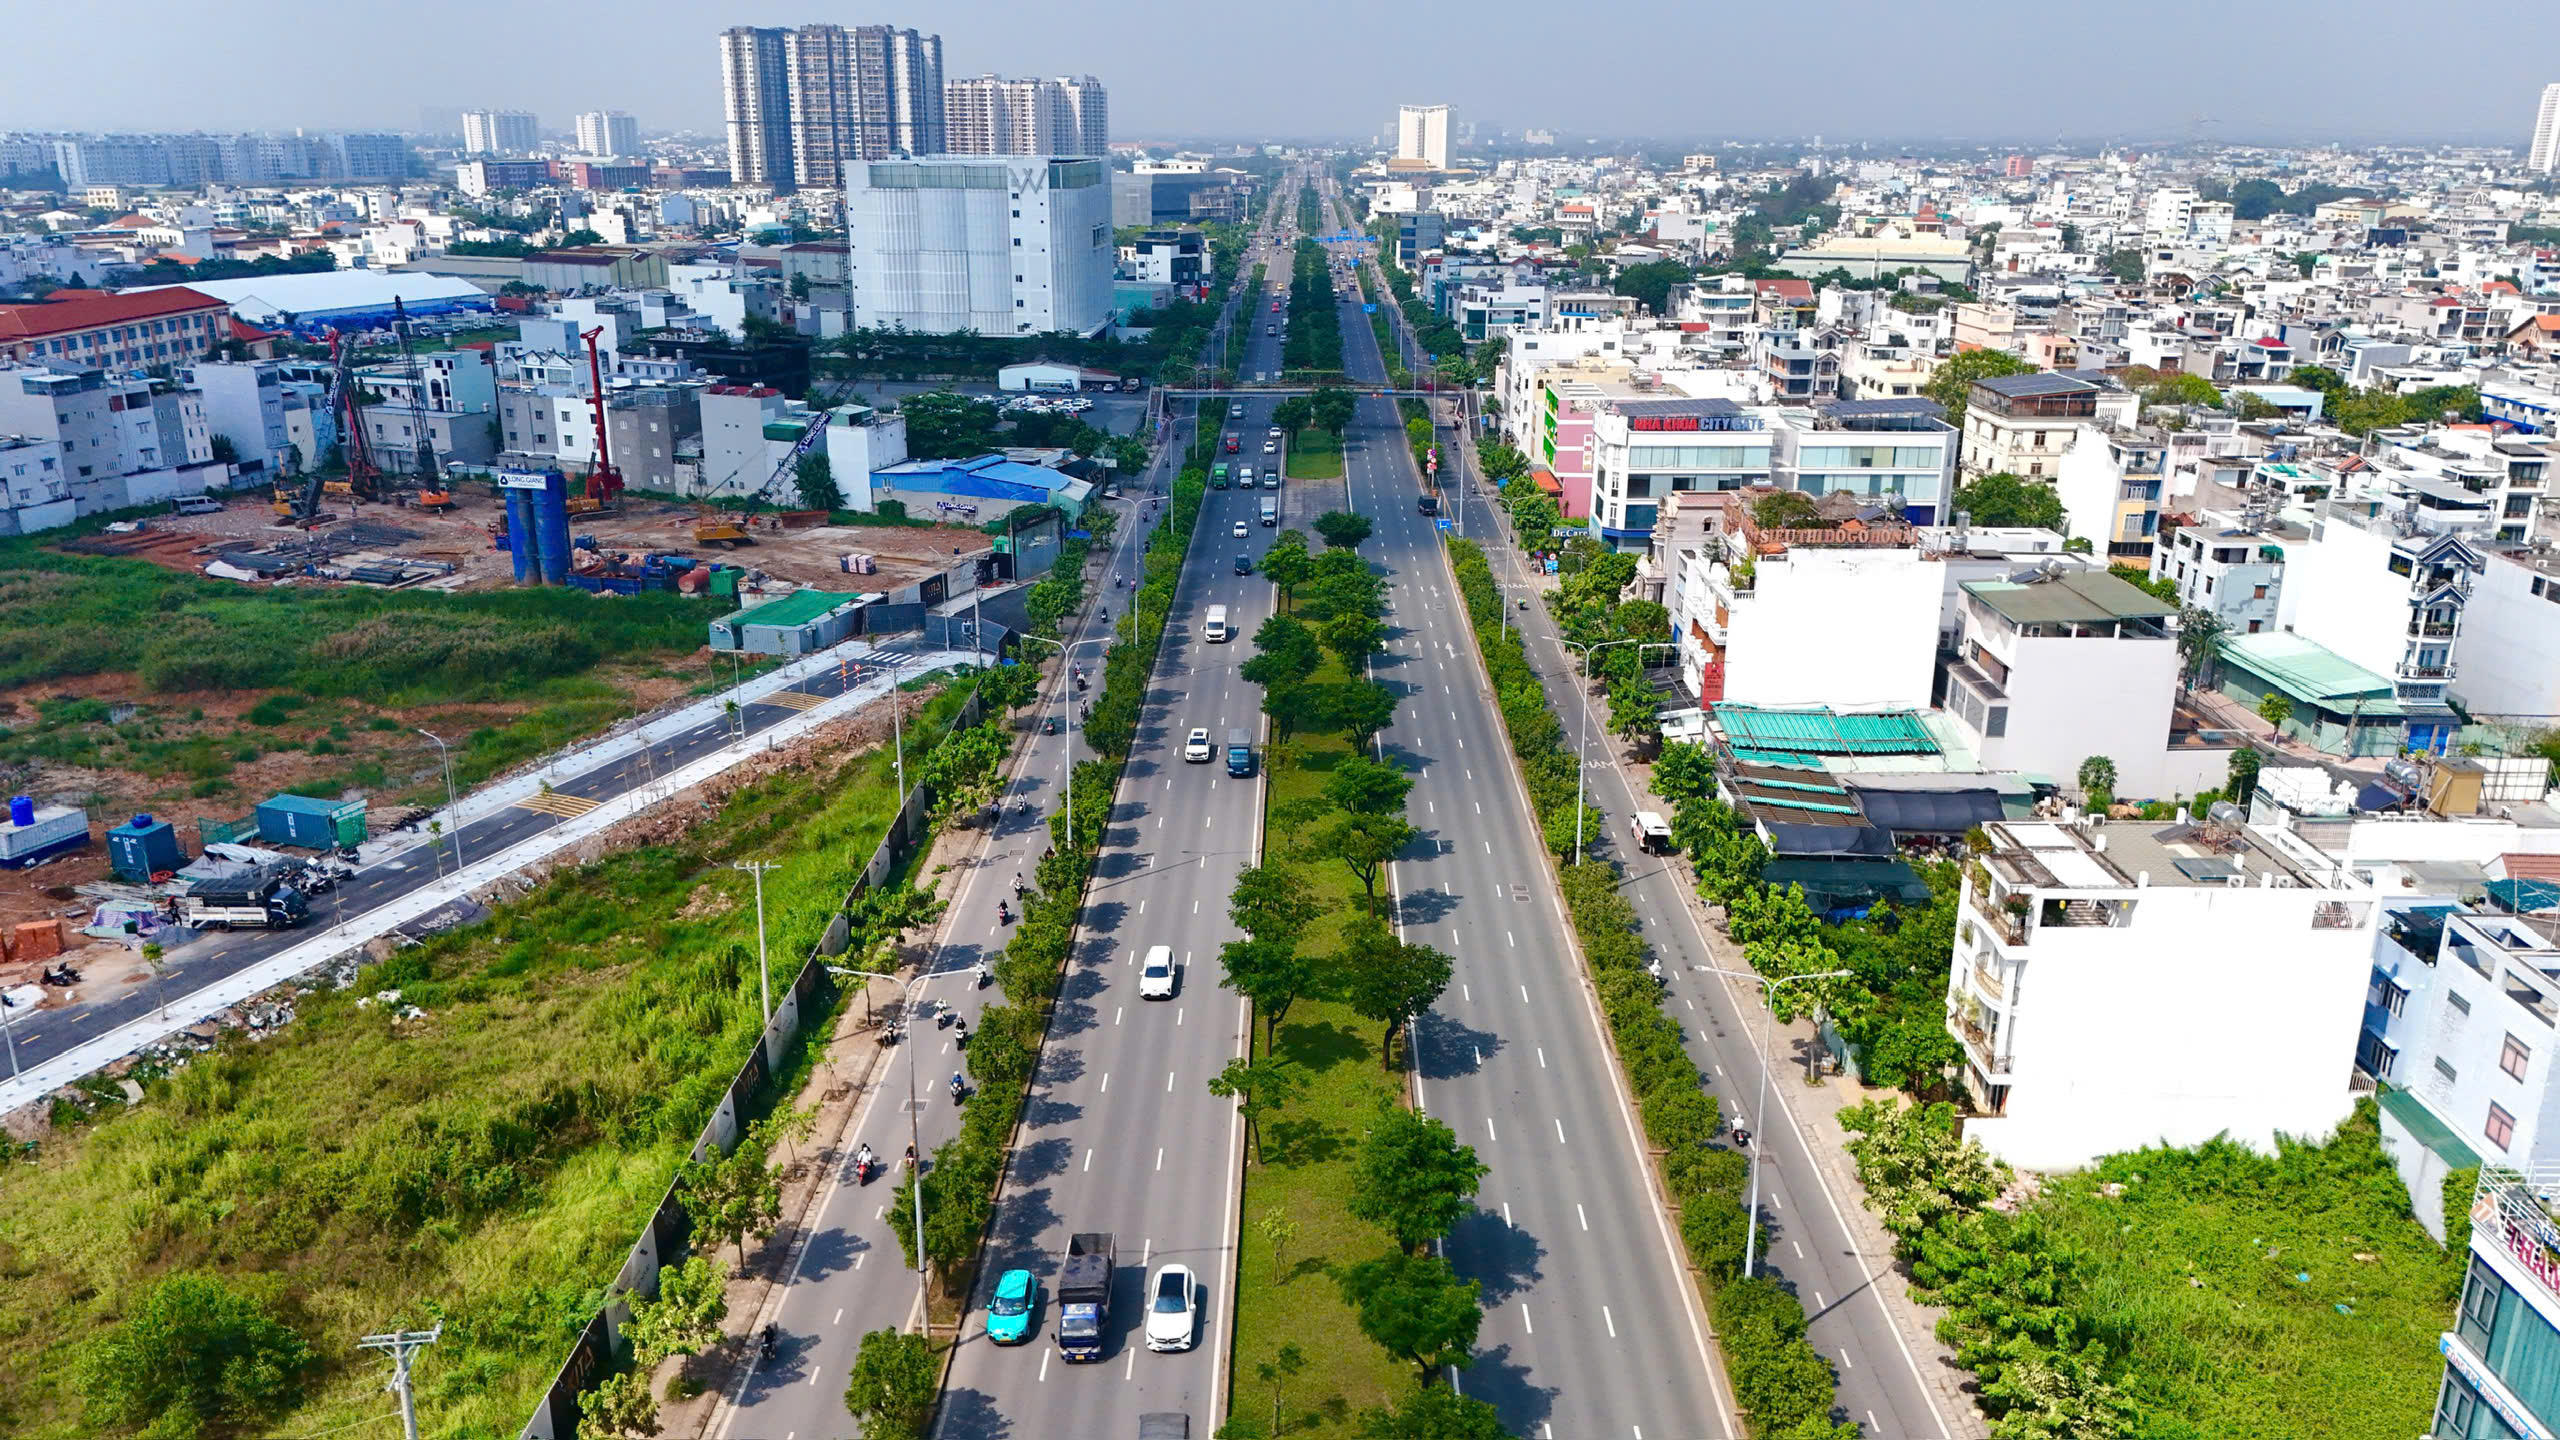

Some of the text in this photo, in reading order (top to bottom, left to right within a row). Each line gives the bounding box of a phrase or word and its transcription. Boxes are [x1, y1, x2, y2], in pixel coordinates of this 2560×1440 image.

[803, 430, 817, 445] LONG
[815, 413, 829, 431] GIANG
[1634, 418, 1661, 431] NHA
[1663, 417, 1698, 431] KHOA
[1700, 417, 1731, 431] CITY
[1553, 529, 1588, 537] Dr.Care
